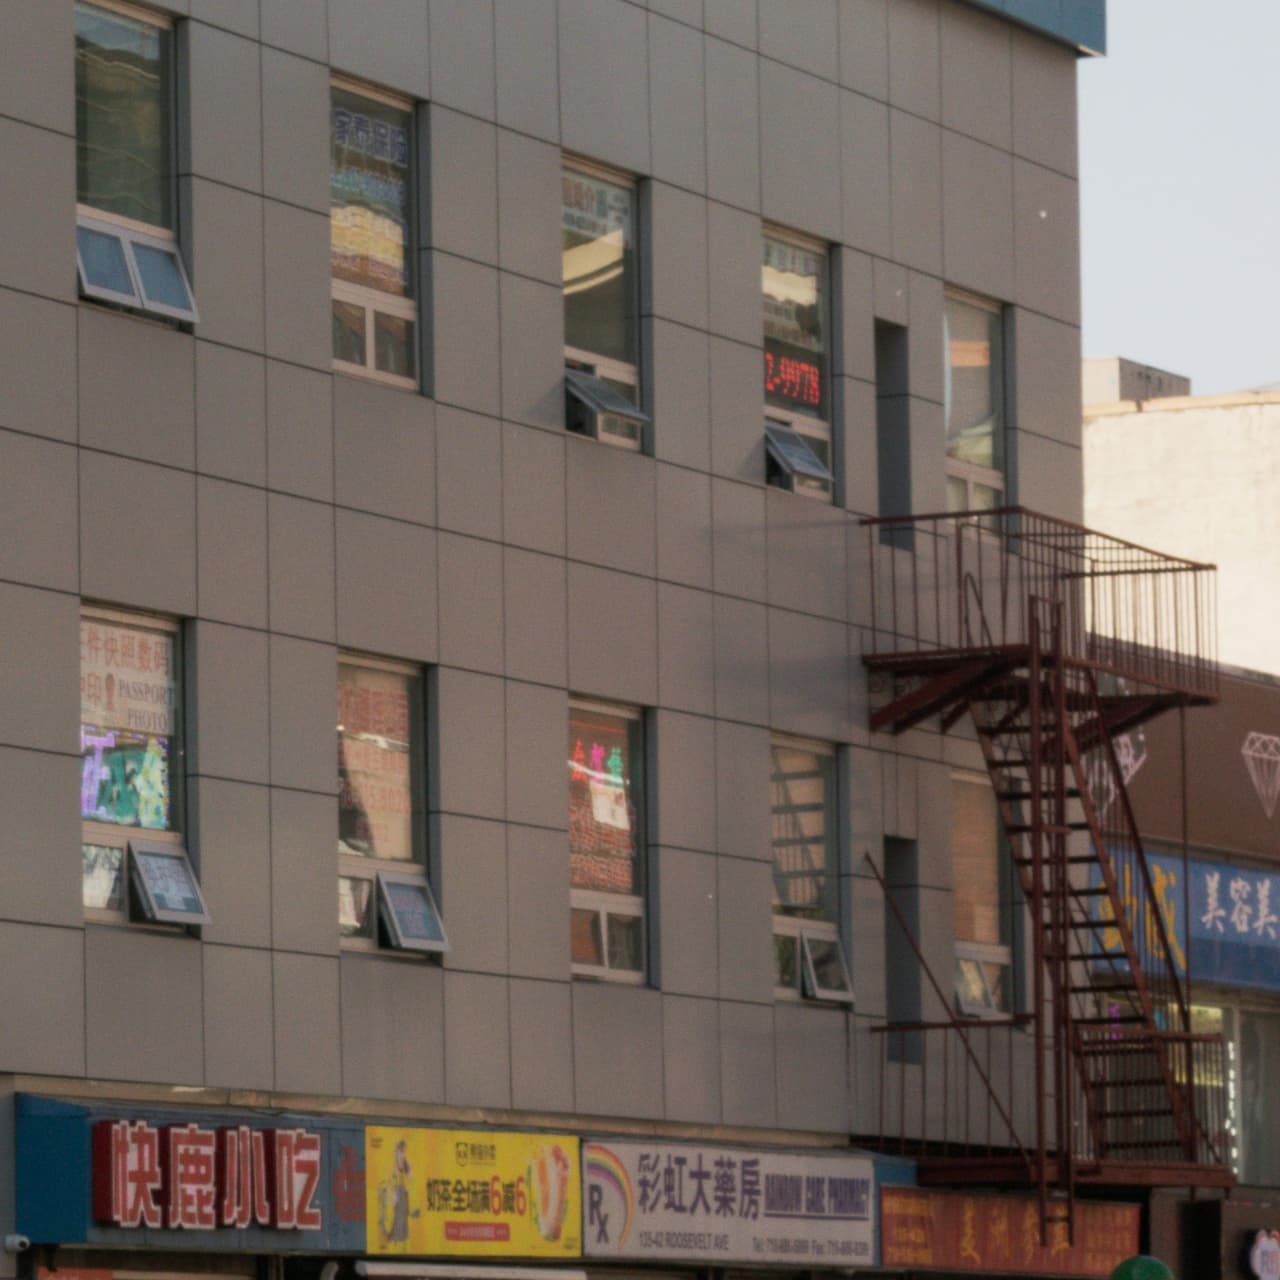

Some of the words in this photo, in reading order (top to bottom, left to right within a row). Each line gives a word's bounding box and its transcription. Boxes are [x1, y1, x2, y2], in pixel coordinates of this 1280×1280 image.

[120, 680, 174, 704] PASSPORT
[128, 708, 168, 731] PHOTO
[111, 1119, 323, 1231] 快鹿小吃
[637, 1153, 762, 1221] 彩虹大藥房
